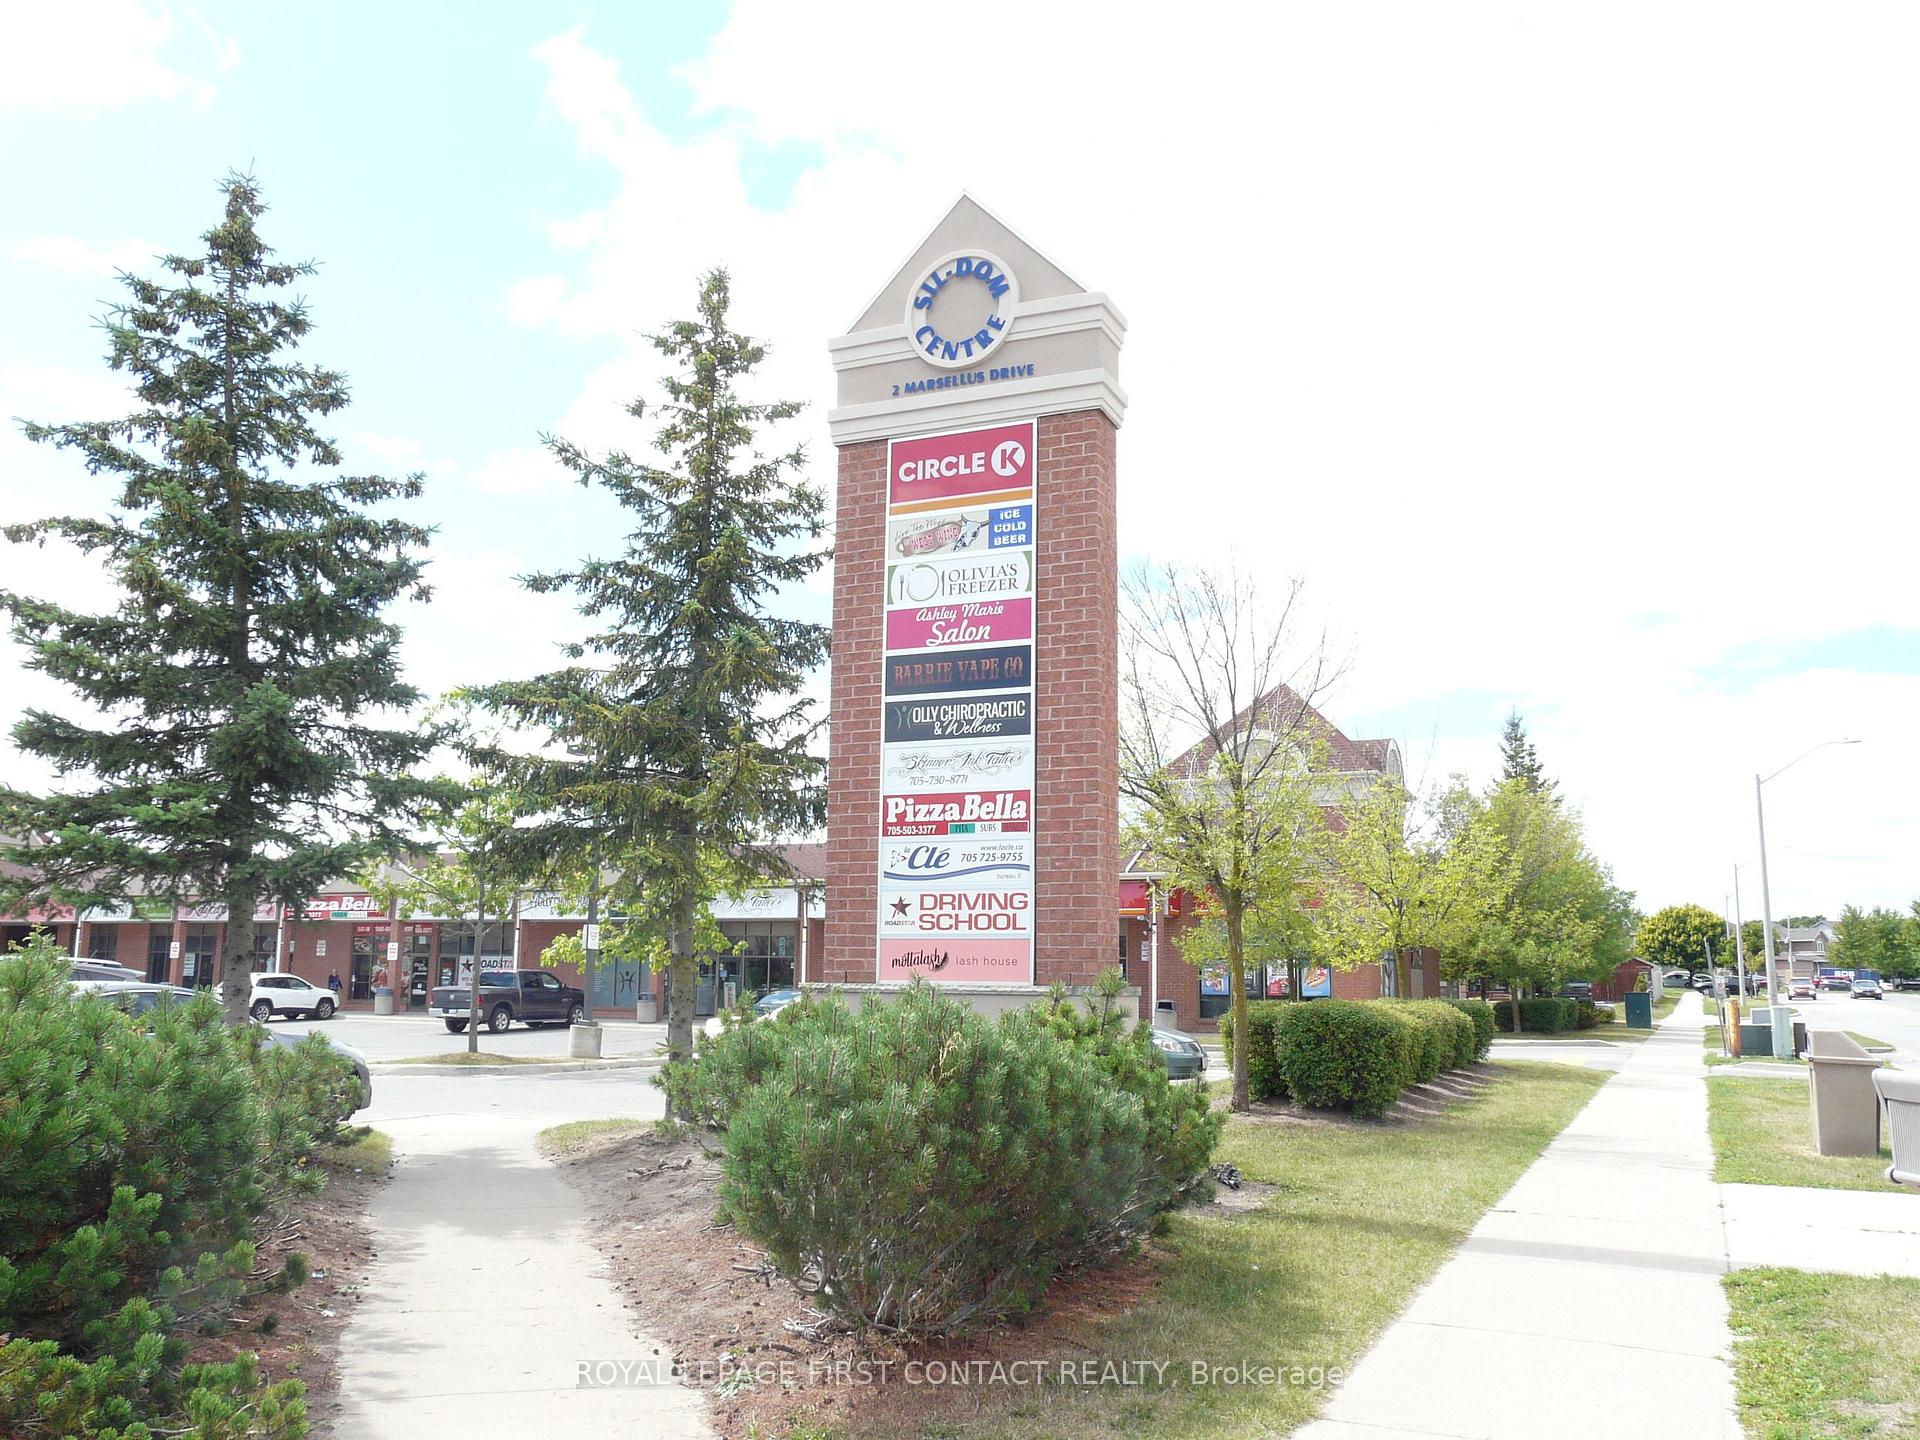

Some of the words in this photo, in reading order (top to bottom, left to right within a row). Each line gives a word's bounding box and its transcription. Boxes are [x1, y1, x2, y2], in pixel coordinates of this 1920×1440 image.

[914, 256, 1010, 311] SIL-DOM
[915, 313, 1007, 361] CENTRE
[891, 384, 899, 397] 2
[904, 371, 985, 394] MARSELLUS
[990, 363, 1036, 382] DRIVE
[898, 451, 986, 483] CIRCLE
[999, 444, 1024, 474] K
[999, 508, 1021, 521] ICE
[993, 520, 1027, 533] COLD
[993, 533, 1027, 546] BEER
[948, 563, 1018, 583] OLIVIA'S
[948, 577, 1020, 596] FREEZER
[916, 606, 957, 622] Ashley
[961, 601, 1004, 618] Marie
[925, 619, 991, 647] Salon
[893, 661, 952, 687] BARRIE
[957, 657, 999, 682] VAPE
[1003, 655, 1024, 679] CO
[940, 700, 1026, 721] CHIROPRACTIC
[933, 721, 942, 736] &
[944, 716, 1003, 736] Wellness
[909, 774, 969, 786] 705-730-8771
[886, 824, 937, 836] 705-503-3377
[979, 823, 997, 832] SUBS
[980, 843, 1024, 851] www.lacle.ca
[960, 853, 978, 863] 705
[979, 852, 1023, 862] 725-9755
[919, 892, 1029, 911] DRIVING
[918, 913, 1027, 931] SCHOOL
[955, 955, 979, 966] lash
[983, 955, 1018, 967] house
